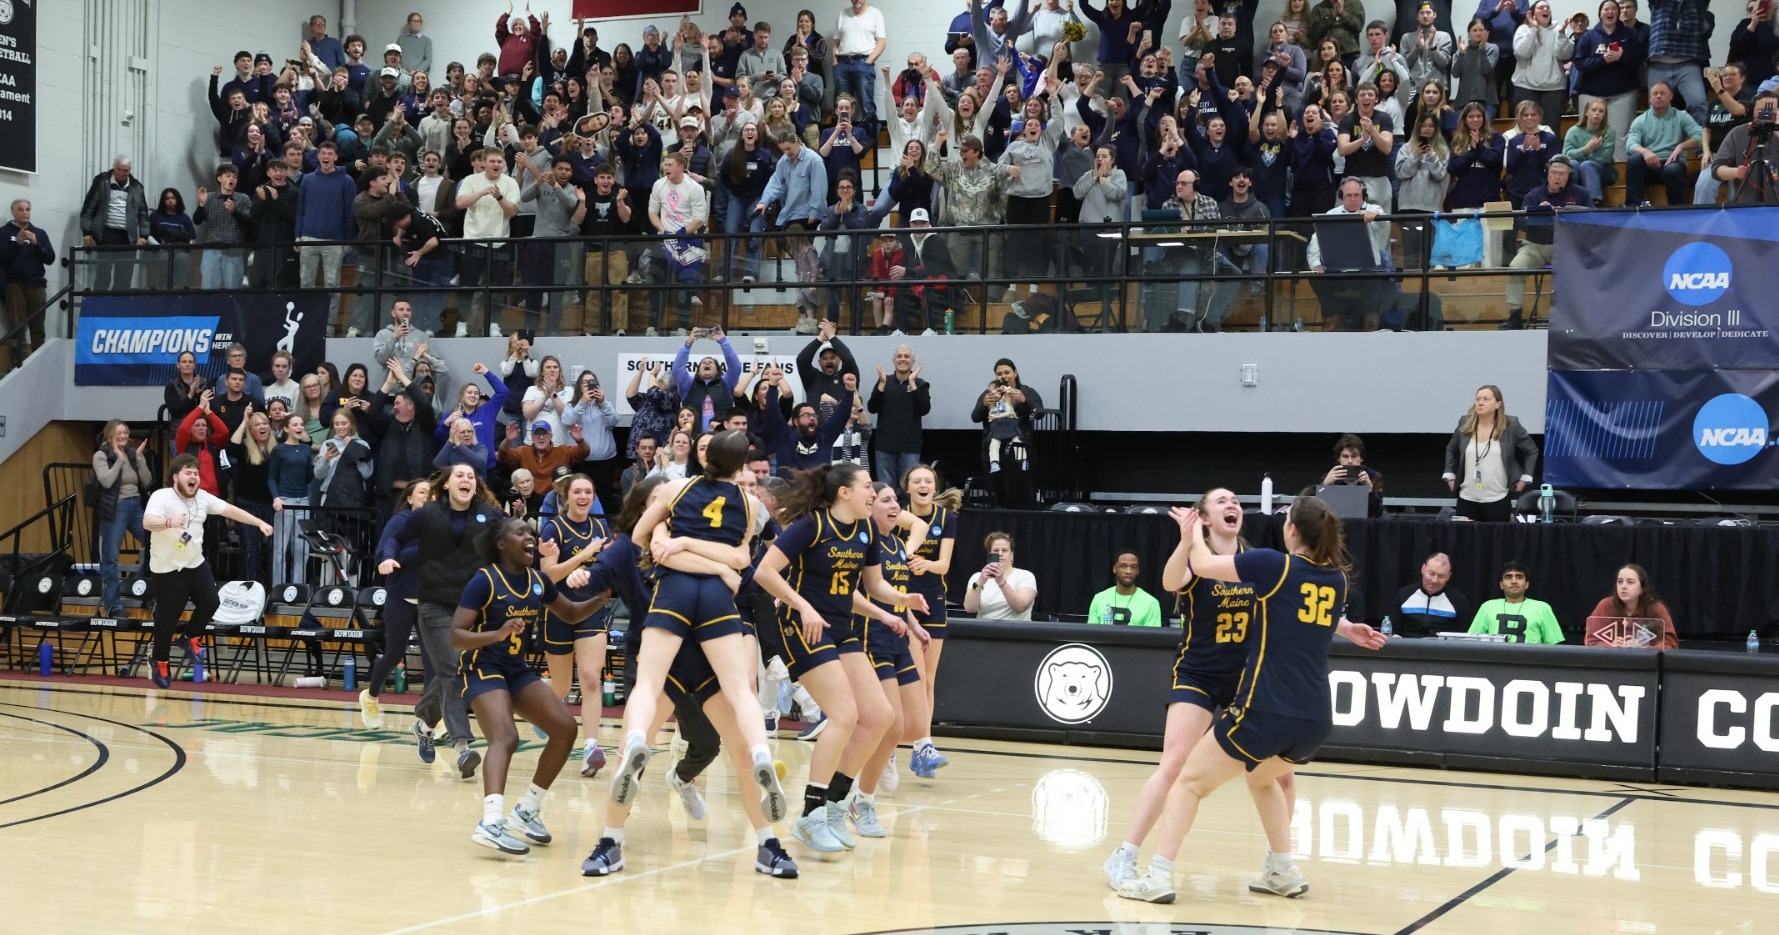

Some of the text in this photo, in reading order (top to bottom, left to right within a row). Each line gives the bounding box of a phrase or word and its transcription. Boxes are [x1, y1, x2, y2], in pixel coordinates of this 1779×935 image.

[1669, 272, 1729, 290] NCAA
[1651, 310, 1740, 327] Division III
[92, 328, 212, 354] CHAMPIONS
[215, 333, 232, 341] WIN
[1622, 331, 1668, 339] DISCOVER
[1721, 330, 1769, 338] DEDICATE
[1700, 427, 1766, 447] NCAA
[702, 495, 727, 528] 4
[827, 546, 864, 559] Southern
[829, 570, 850, 595] 15
[1211, 584, 1255, 597] Southern
[1217, 596, 1250, 608] Maine
[1297, 582, 1336, 627] 32
[90, 618, 118, 627] BOWDOIN
[240, 625, 266, 634] BOWDOIN
[1215, 612, 1249, 644] 23
[1496, 613, 1528, 643] B
[334, 629, 363, 638] BOWDOIN
[508, 631, 522, 655] 5
[1328, 670, 1645, 743] OWDOIN
